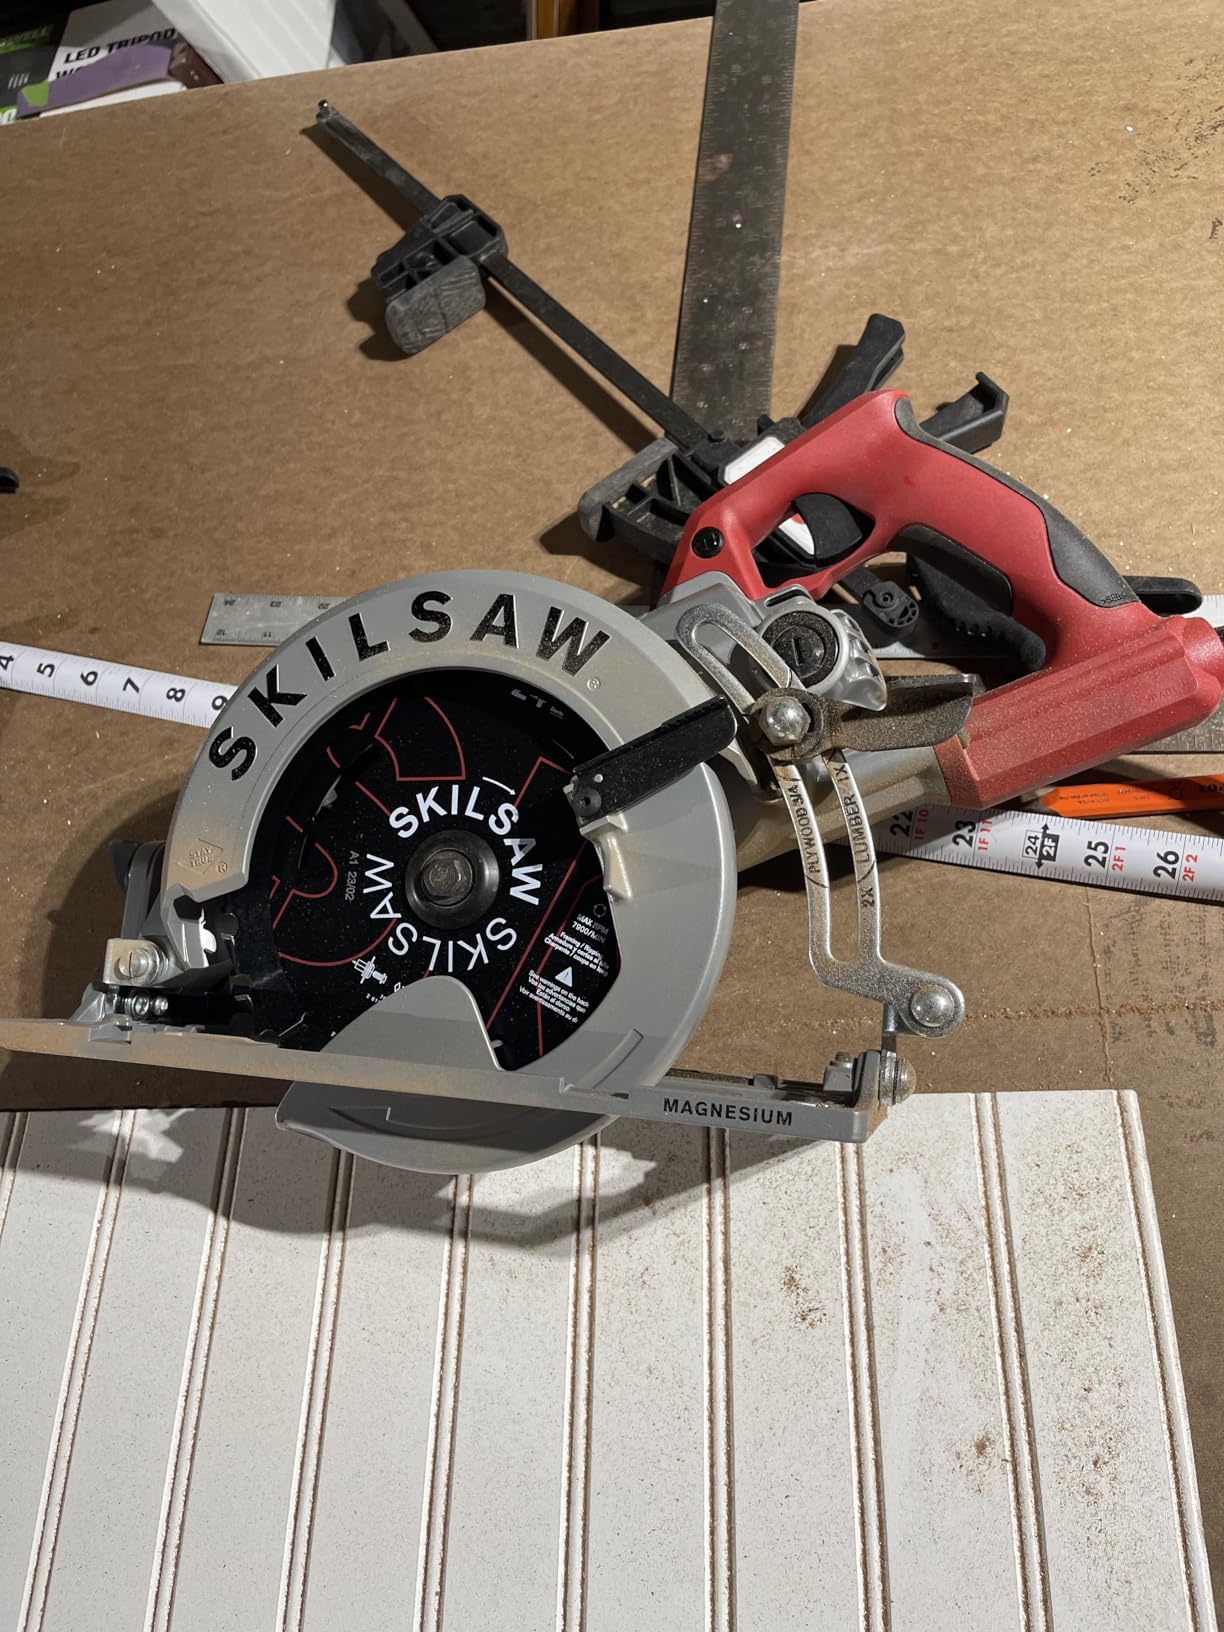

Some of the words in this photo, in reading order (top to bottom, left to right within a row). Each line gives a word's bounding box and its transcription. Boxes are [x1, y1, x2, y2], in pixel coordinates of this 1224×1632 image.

[64, 46, 101, 64] LED
[105, 28, 176, 53] TRIPOD
[37, 663, 55, 677] 5
[80, 671, 98, 686] 6
[123, 677, 140, 693] 7
[166, 688, 186, 702] 8
[208, 590, 612, 781] SKILSAW
[890, 810, 914, 837] 22
[952, 820, 976, 848] 23
[389, 784, 543, 906] SKILSAW
[796, 807, 821, 874] PLYWOOD
[978, 837, 990, 851] 1F
[1025, 834, 1039, 855] 24
[1043, 837, 1057, 857] 2F
[350, 850, 360, 865] A1
[1083, 840, 1110, 869] 25
[1111, 855, 1125, 872] 2F
[1153, 850, 1180, 880] 26
[1186, 854, 1198, 863] 2
[1182, 866, 1196, 882] 2F
[345, 871, 357, 901] 23/02
[362, 853, 517, 972] SKILSAW
[577, 914, 592, 925] MAX
[592, 922, 608, 934] RPM
[663, 1097, 793, 1126] MAGNESIUM
